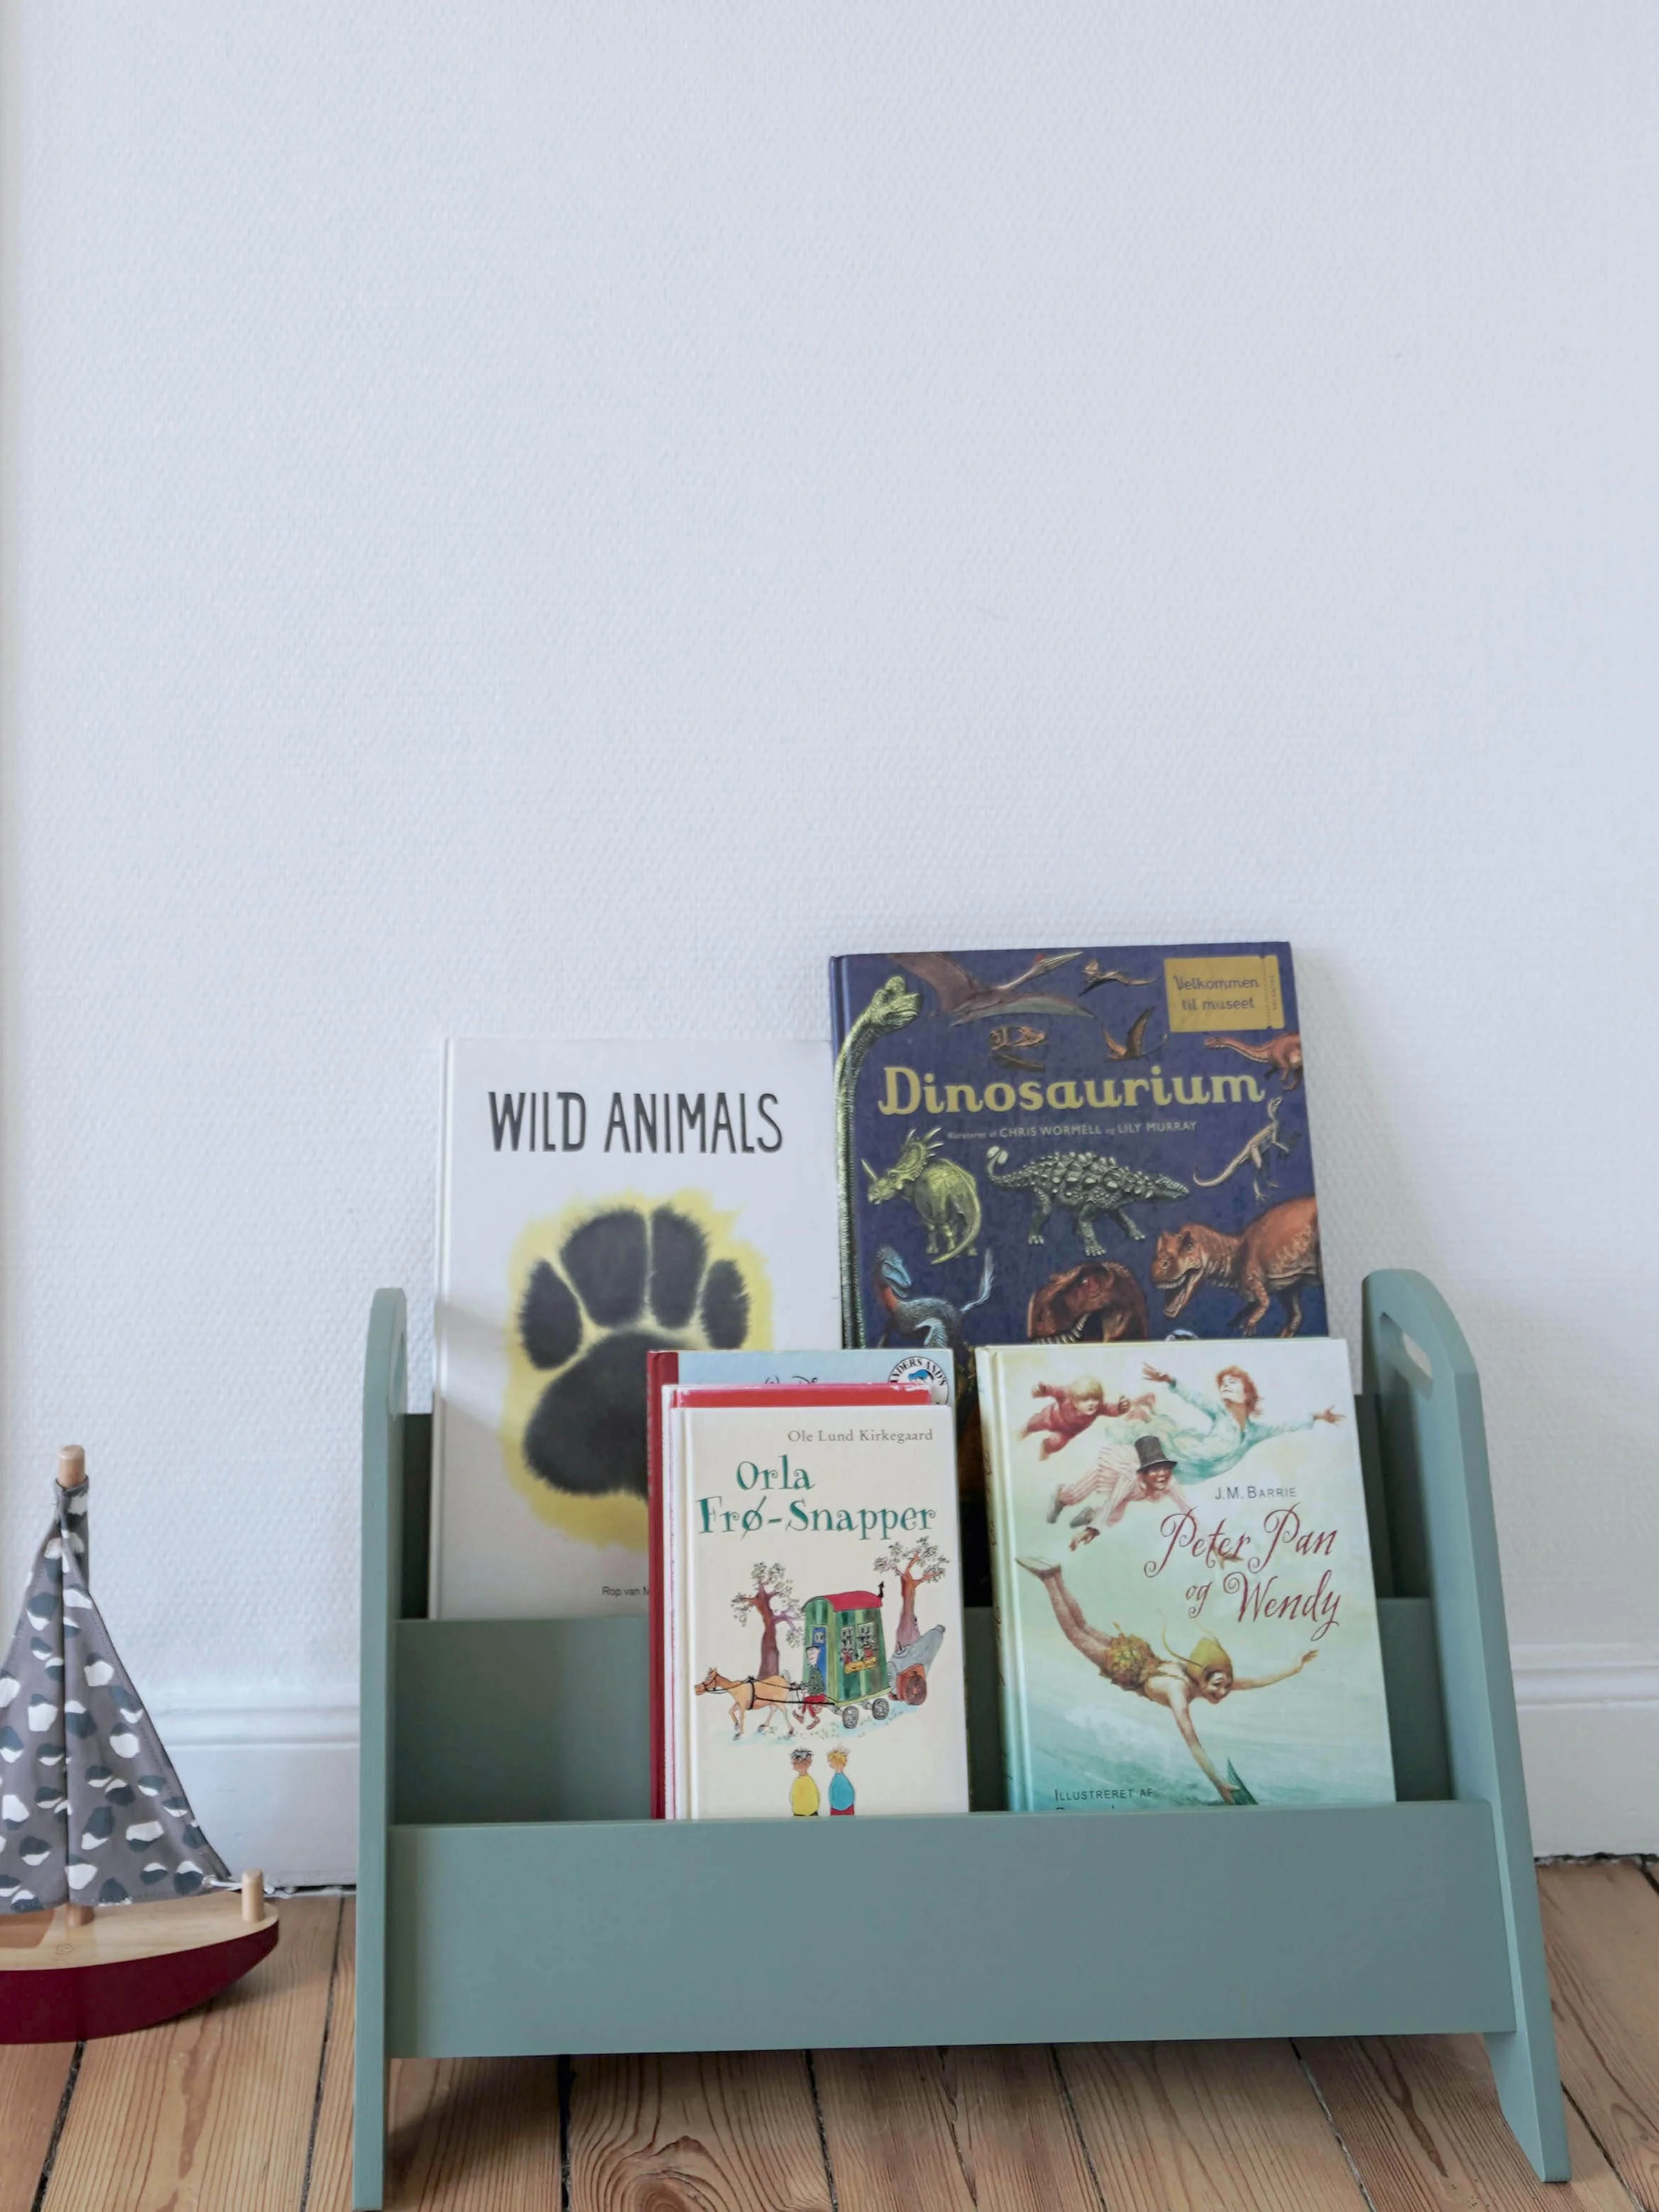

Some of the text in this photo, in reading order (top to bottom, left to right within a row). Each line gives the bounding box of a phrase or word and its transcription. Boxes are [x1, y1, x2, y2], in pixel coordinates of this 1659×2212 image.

[1173, 975, 1260, 991] Velkommen
[1181, 997, 1255, 1011] til museet
[878, 1065, 1265, 1116] Dinosaurium
[488, 1091, 784, 1154] WILD ANIMALS
[999, 1127, 1037, 1138] CHRIS
[1039, 1125, 1103, 1136] WORMELL
[1117, 1123, 1141, 1134] LILY
[1145, 1121, 1198, 1133] MURRAY
[787, 1428, 933, 1444] Ole Lund Kirkegaard
[736, 1454, 815, 1491] Orla
[1214, 1486, 1242, 1500] J.M.
[695, 1495, 937, 1541] Frø-Snapper
[1143, 1502, 1339, 1578] Peter Pan
[1185, 1569, 1342, 1642] og Wendy
[1054, 1787, 1154, 1802] ILLUSTRERET AF
